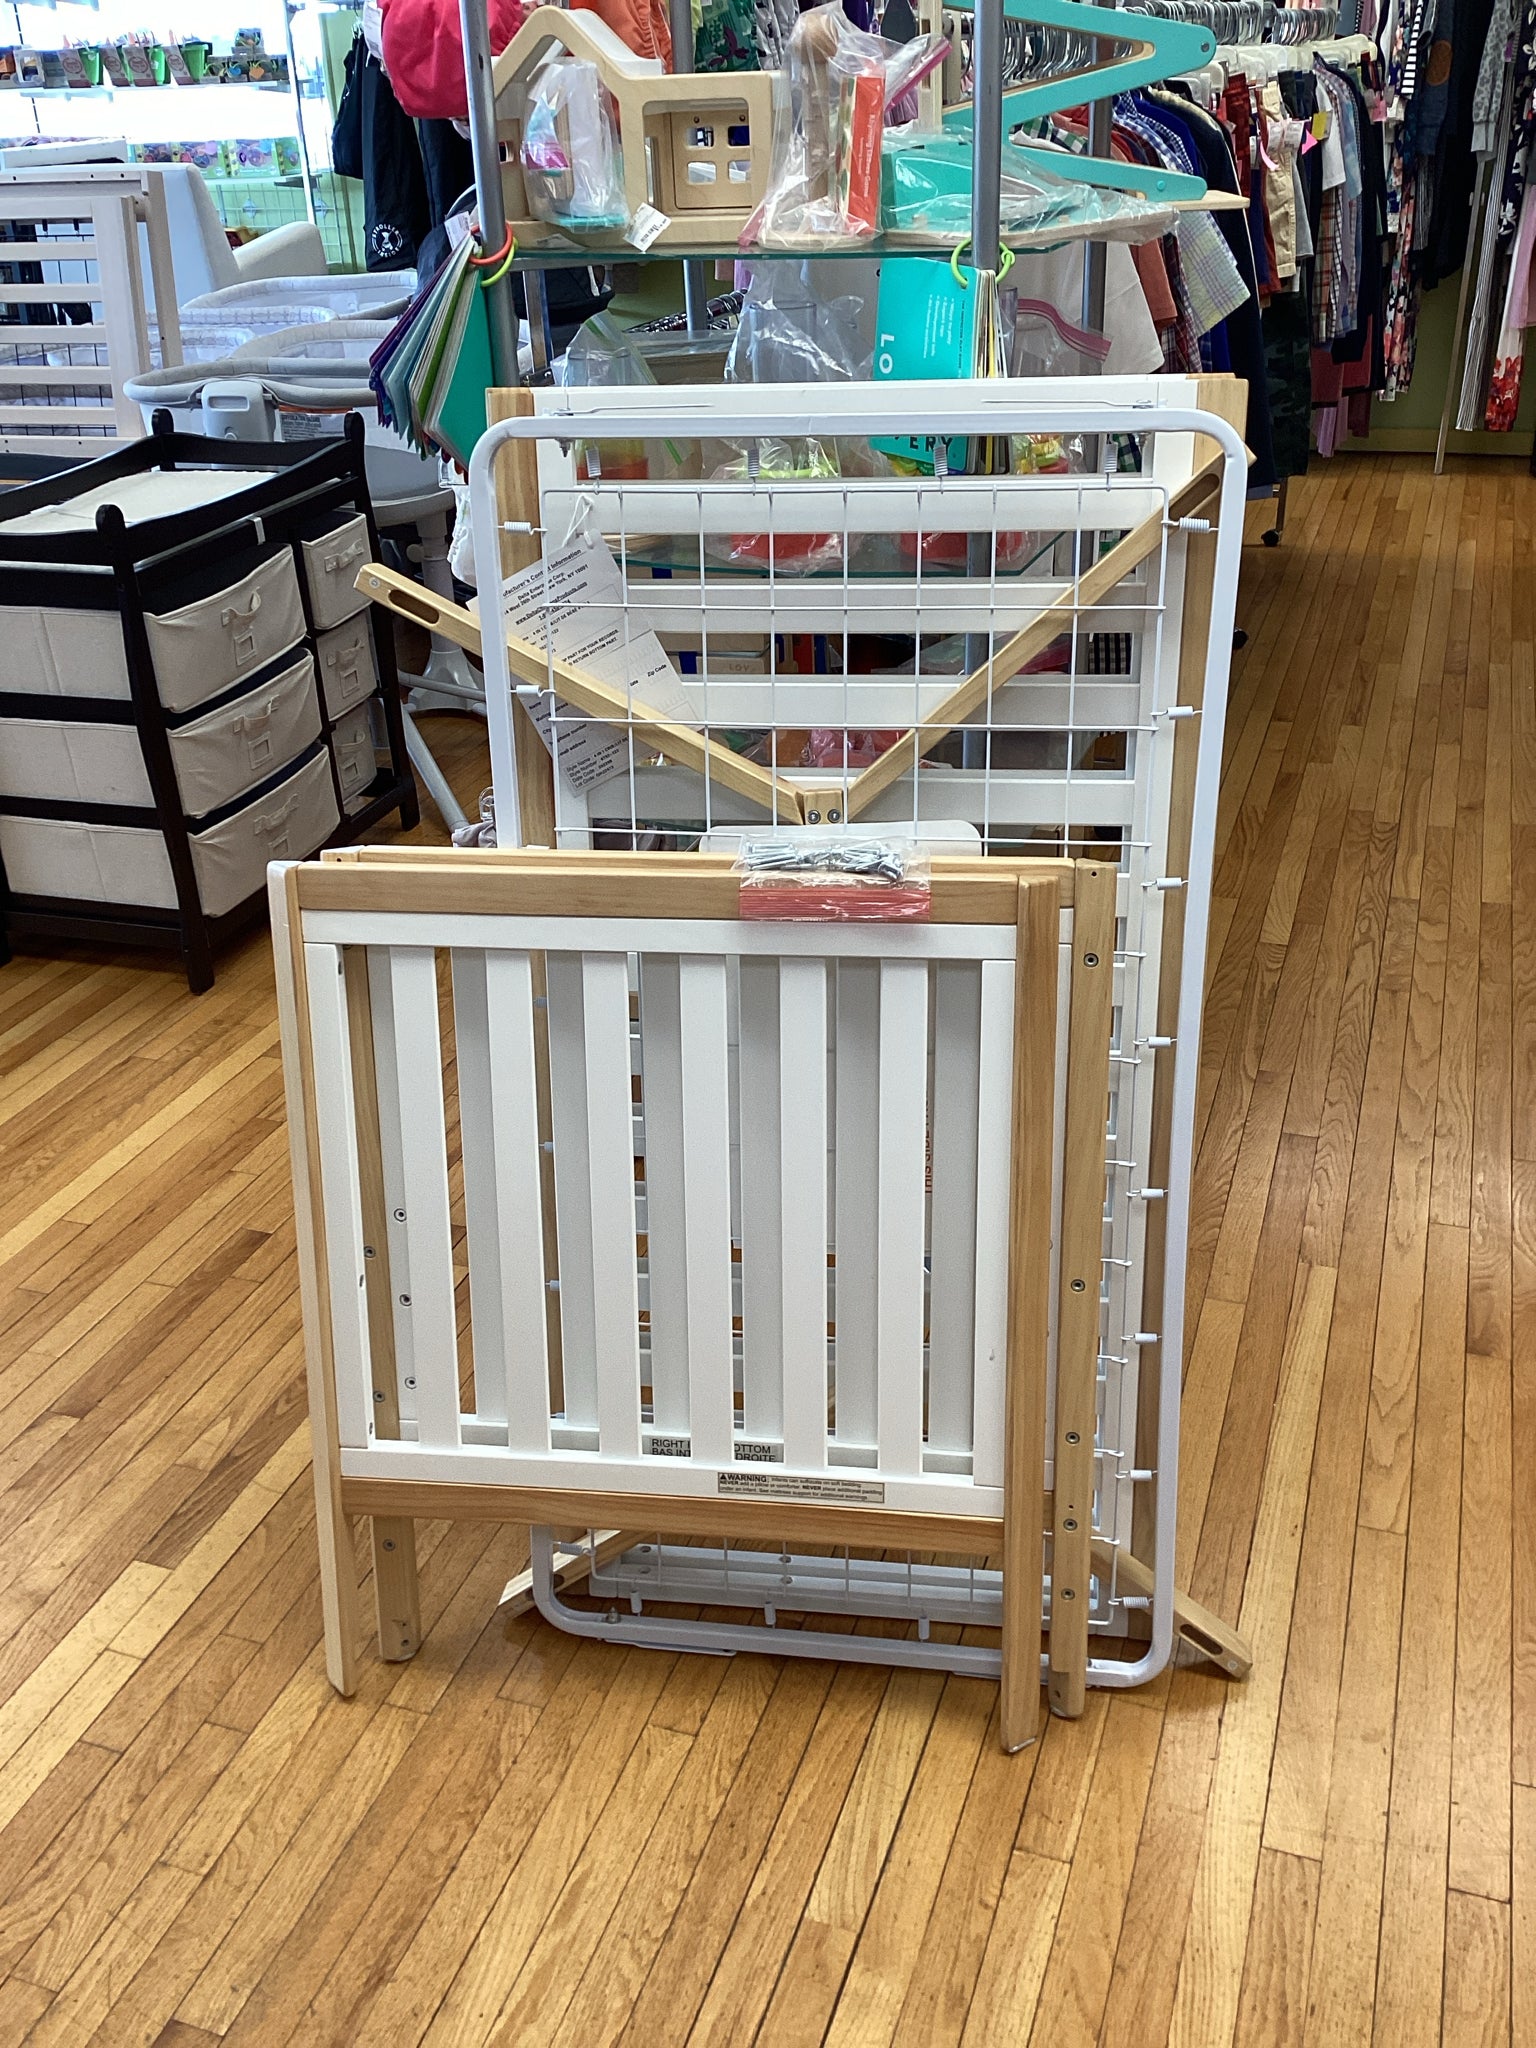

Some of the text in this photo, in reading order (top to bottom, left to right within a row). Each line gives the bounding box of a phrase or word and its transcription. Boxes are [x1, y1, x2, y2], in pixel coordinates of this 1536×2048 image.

[550, 549, 582, 569] Information
[655, 663, 666, 671] Code
[652, 1438, 684, 1448] RIGHT
[652, 1447, 673, 1456] BAS
[735, 1453, 775, 1462] DROITE
